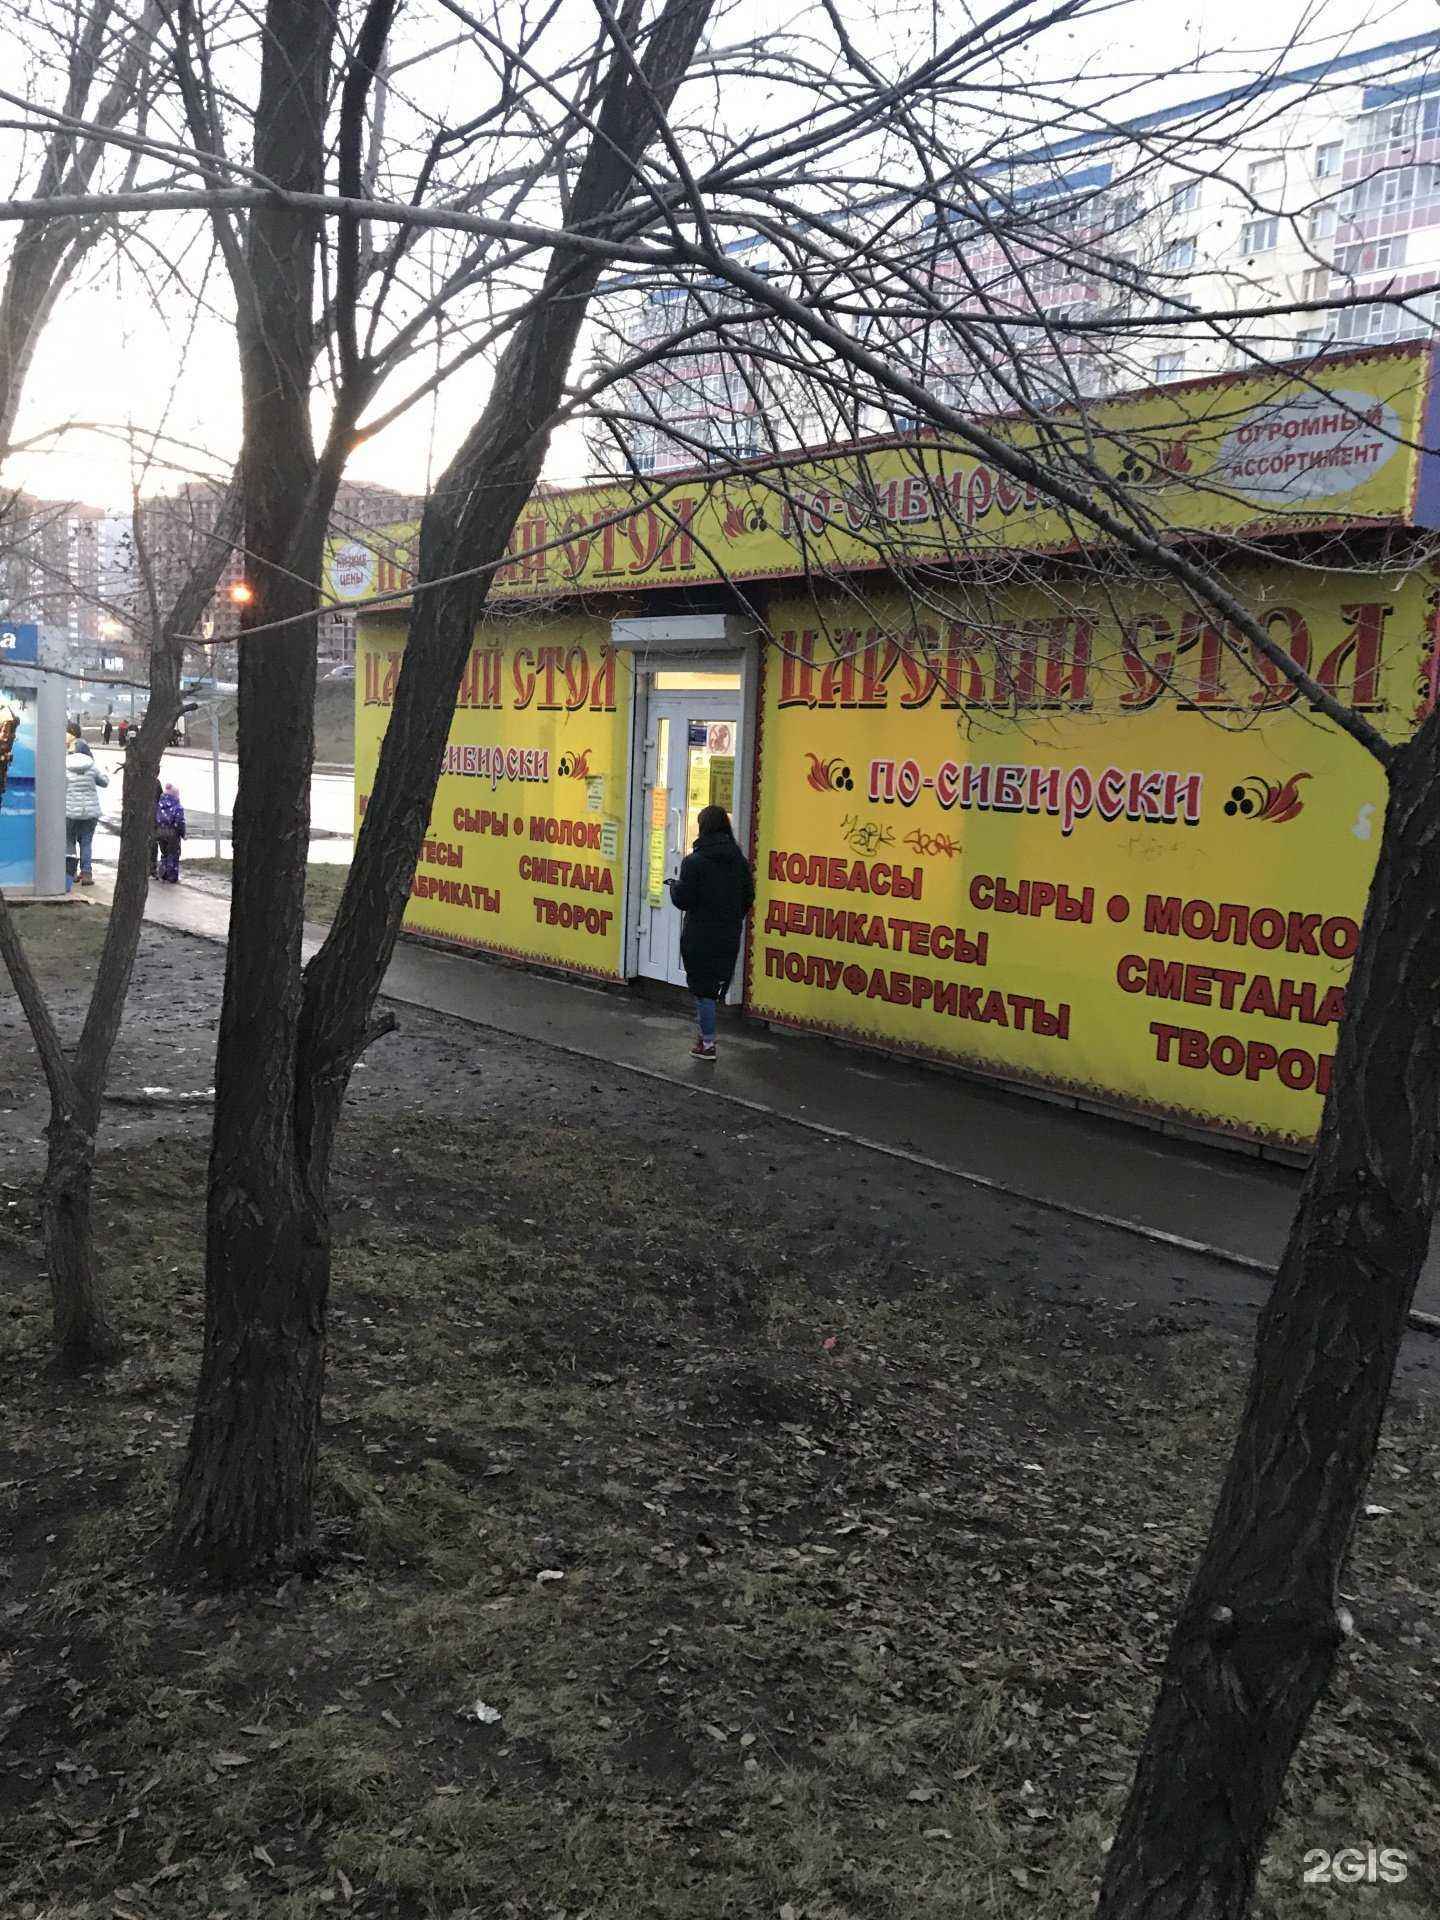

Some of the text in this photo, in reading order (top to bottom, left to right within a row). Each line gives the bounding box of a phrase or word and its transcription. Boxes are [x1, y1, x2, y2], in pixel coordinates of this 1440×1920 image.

[1236, 406, 1384, 446] ОГРОМНЫЙ
[1231, 443, 1384, 480] АССОРТИМЕНТ
[340, 571, 364, 587] ЦЕНЫ
[513, 643, 617, 713] СТОЛ
[1119, 601, 1395, 713] СТОЛ
[453, 807, 509, 837] СЫРЫ
[529, 816, 602, 850] МОЛОК
[519, 854, 614, 895] СМЕТАНА
[768, 850, 923, 900] КОЛБАСЫ
[533, 897, 613, 936] ТВОРОГ
[764, 899, 989, 966] ДЕЛИКАТЕСЫ
[969, 874, 1361, 960] СЫРЫ МОЛОКО
[765, 946, 1071, 1040] ПОЛУФАБРИКАТЫ
[1116, 954, 1345, 1027] СМЕТАНА
